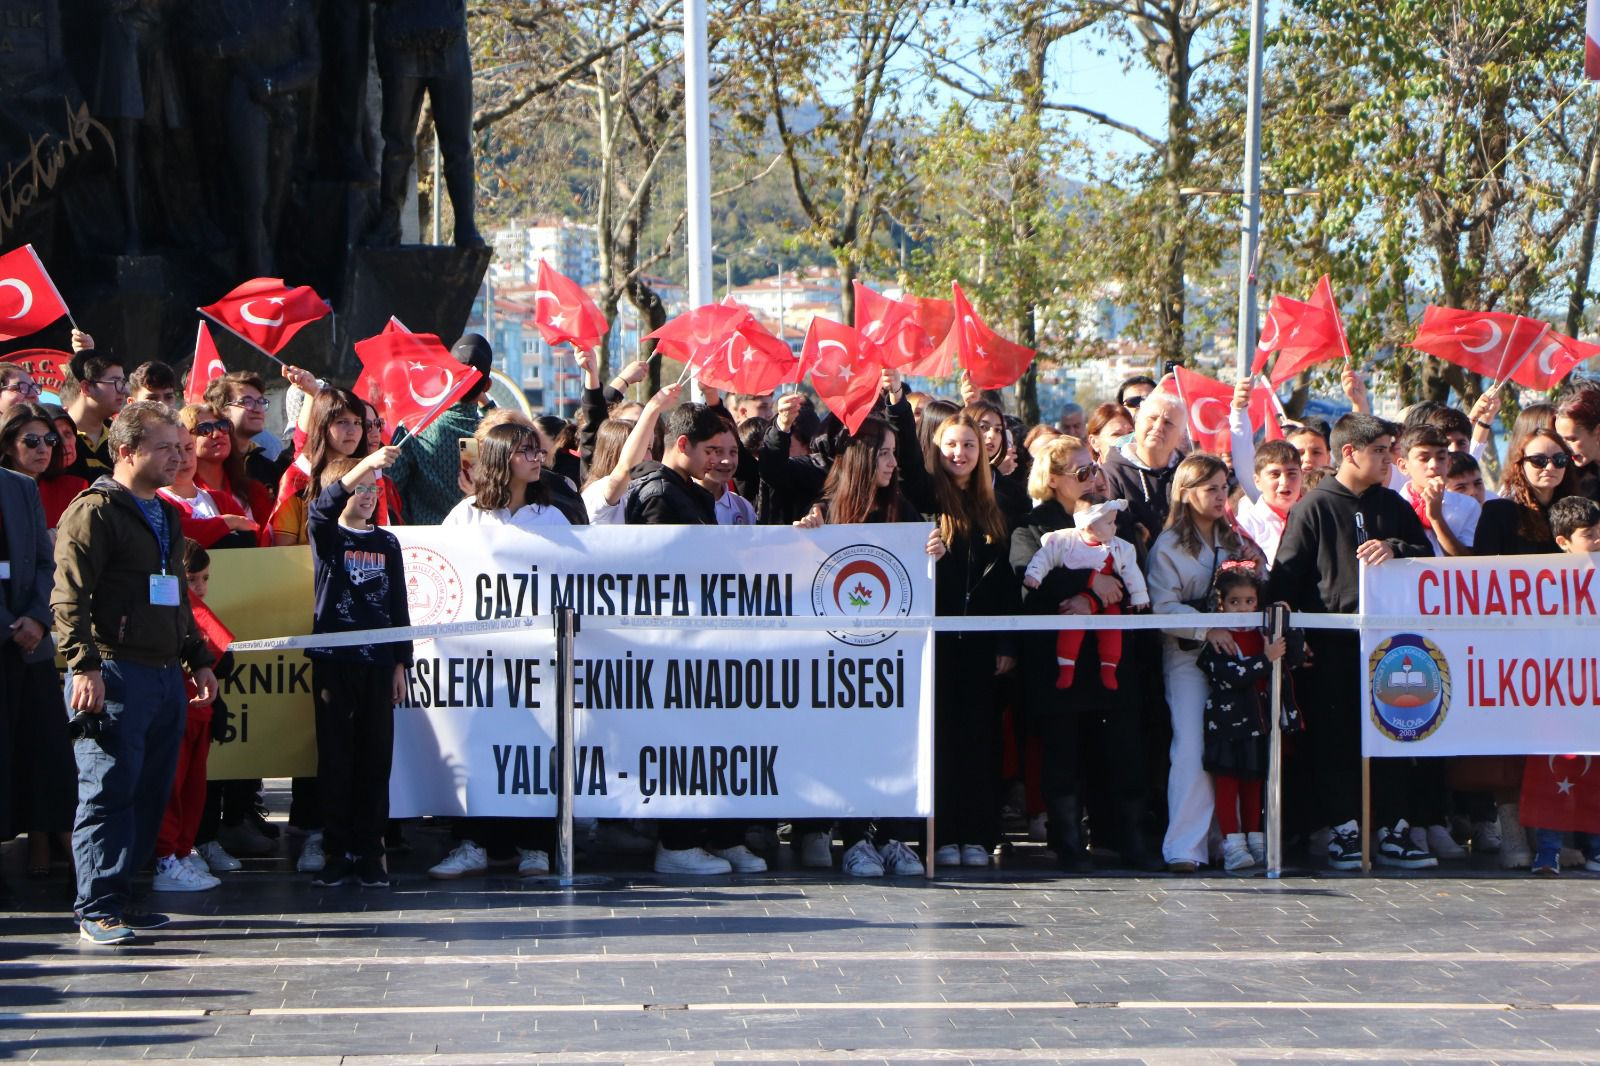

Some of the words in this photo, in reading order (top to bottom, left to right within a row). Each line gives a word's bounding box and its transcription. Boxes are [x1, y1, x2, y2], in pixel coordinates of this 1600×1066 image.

[475, 565, 538, 620] GAZİ
[393, 650, 494, 708] ESLEKİ
[504, 658, 540, 708] VE
[664, 658, 800, 709] ANADOLU
[811, 649, 904, 708] LİSESİ
[639, 745, 779, 804] ÇINARCIK
